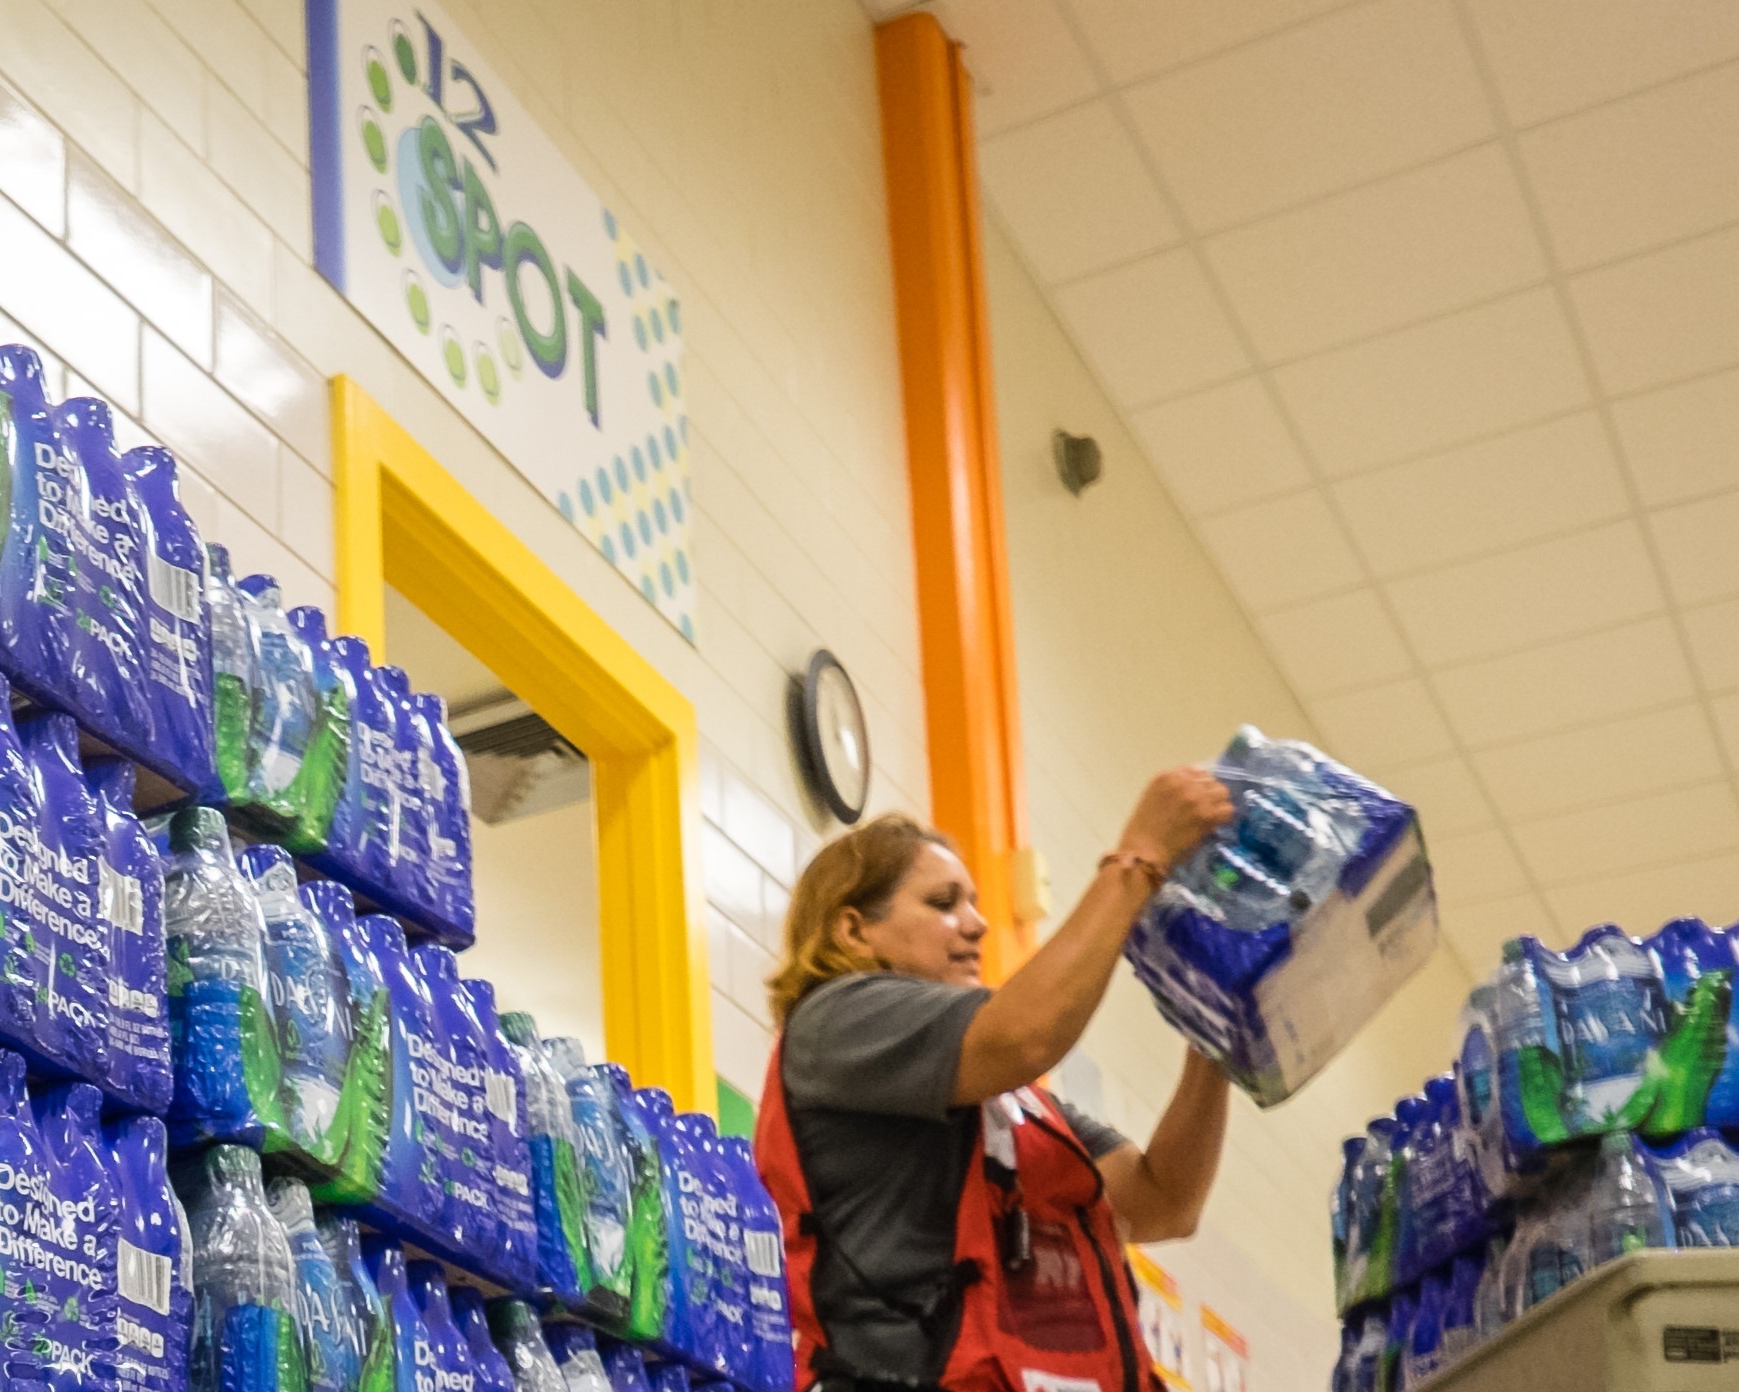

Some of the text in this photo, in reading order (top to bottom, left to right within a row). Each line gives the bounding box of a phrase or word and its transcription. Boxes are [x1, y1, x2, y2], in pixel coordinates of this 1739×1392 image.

[416, 113, 606, 431] SPOT
[1561, 1006, 1666, 1046] DAANI
[23, 1202, 78, 1251] Make
[83, 1235, 96, 1257] a
